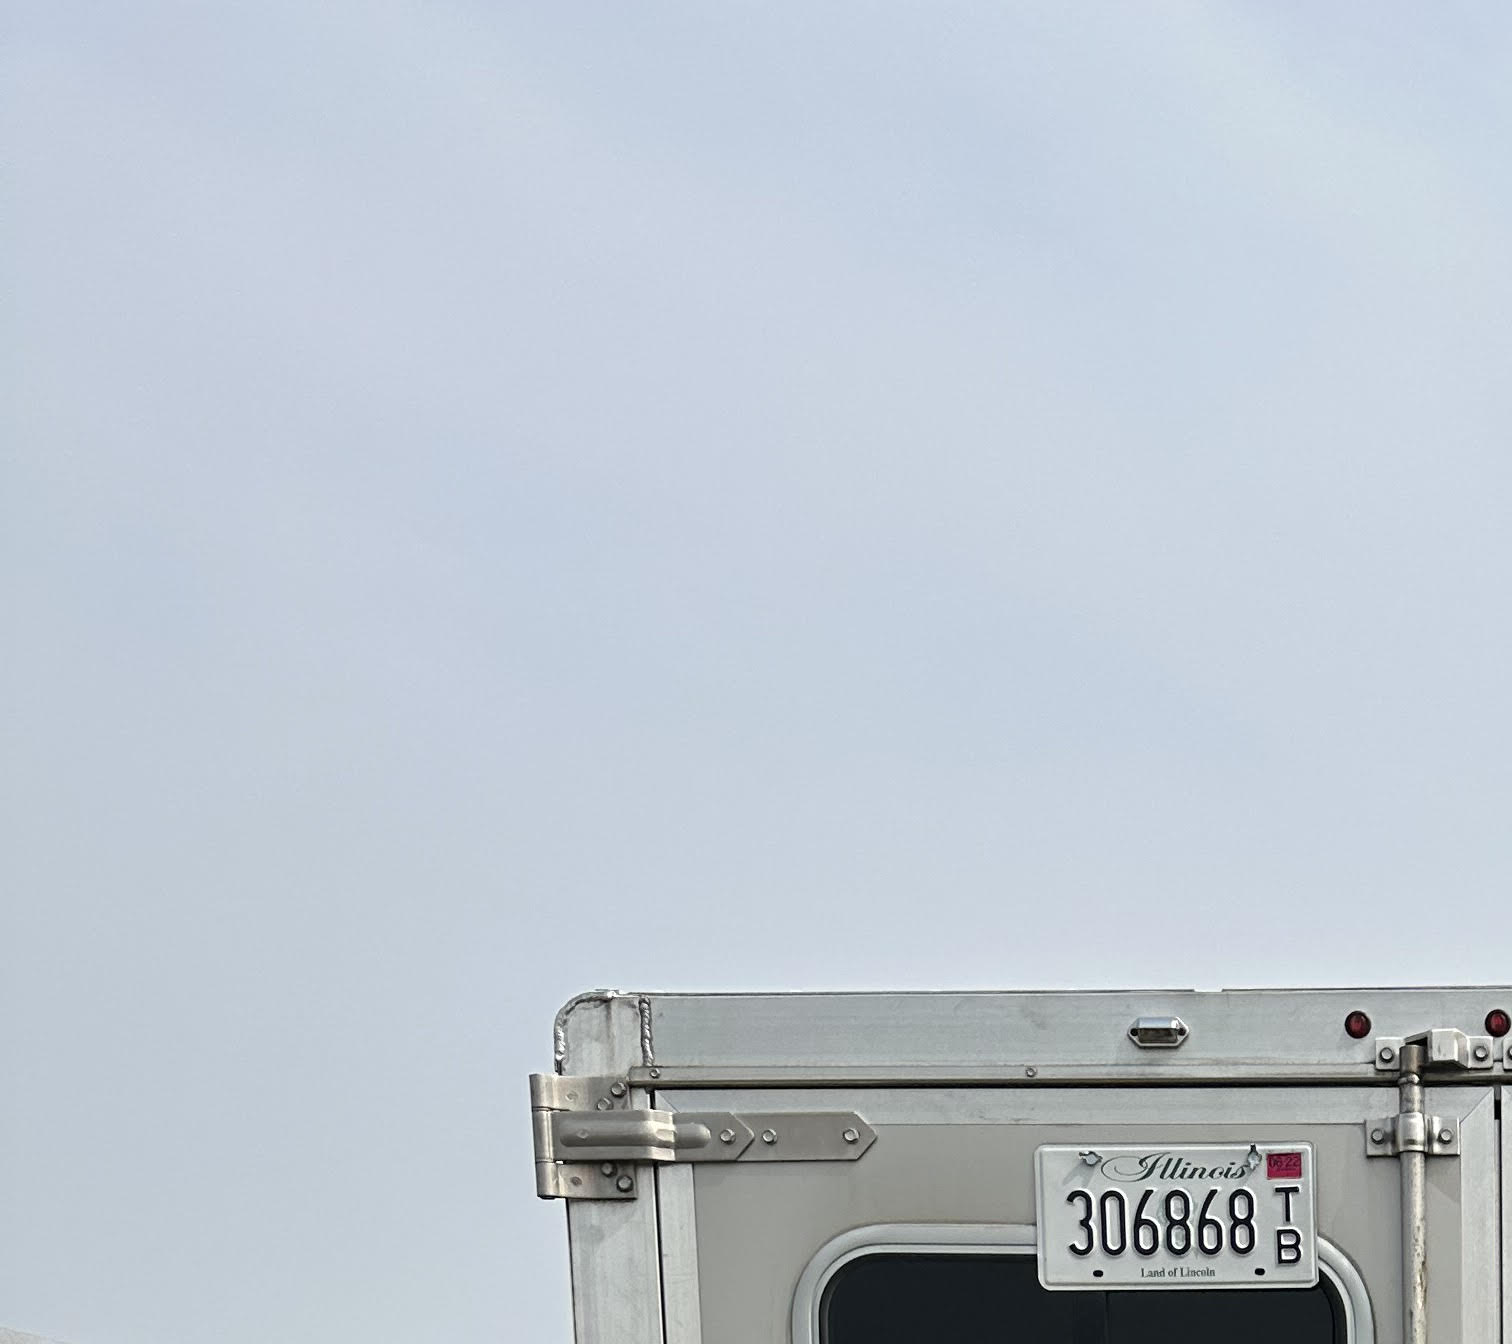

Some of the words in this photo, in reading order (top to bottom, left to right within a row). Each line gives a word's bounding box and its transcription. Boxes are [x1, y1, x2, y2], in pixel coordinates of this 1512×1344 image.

[1100, 1152, 1248, 1182] Illinois
[1066, 1189, 1256, 1256] 306868
[1141, 1267, 1165, 1278] Land
[1168, 1267, 1178, 1278] of
[1180, 1266, 1216, 1278] Lincoln
